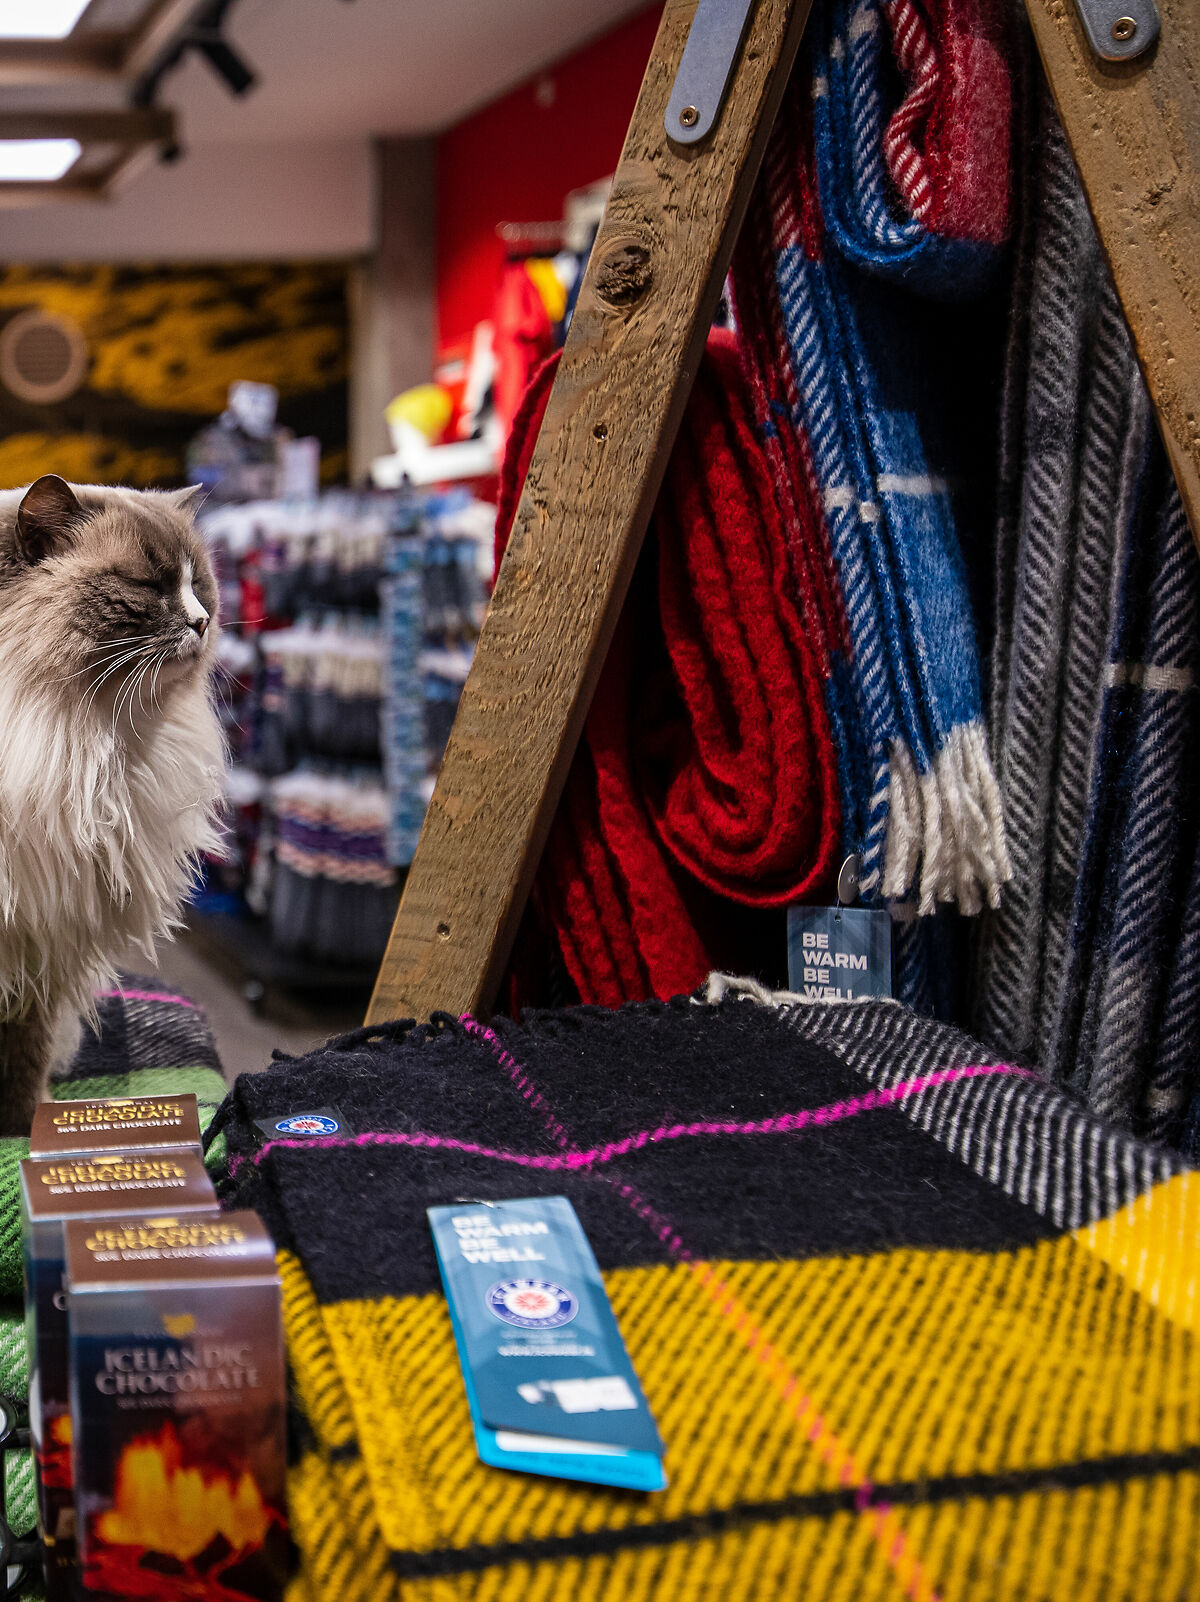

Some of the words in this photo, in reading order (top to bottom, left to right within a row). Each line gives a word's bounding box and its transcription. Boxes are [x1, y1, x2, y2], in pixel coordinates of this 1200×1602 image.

[802, 932, 829, 949] BE
[802, 950, 868, 971] WARM
[803, 967, 830, 984] BE
[53, 1108, 185, 1126] CHOCOLATE
[63, 1103, 179, 1119] ICELANDIC
[113, 1119, 181, 1130] CHOCOLATE
[41, 1167, 186, 1185] CHOCOLATE
[49, 1161, 178, 1178] ICELANDIC
[451, 1214, 491, 1228] BE
[454, 1221, 550, 1238] WARM
[458, 1238, 499, 1251] BE
[461, 1247, 546, 1263] WELL
[104, 1346, 251, 1372] ICELANDIC
[95, 1368, 259, 1395] CHOCOLATE
